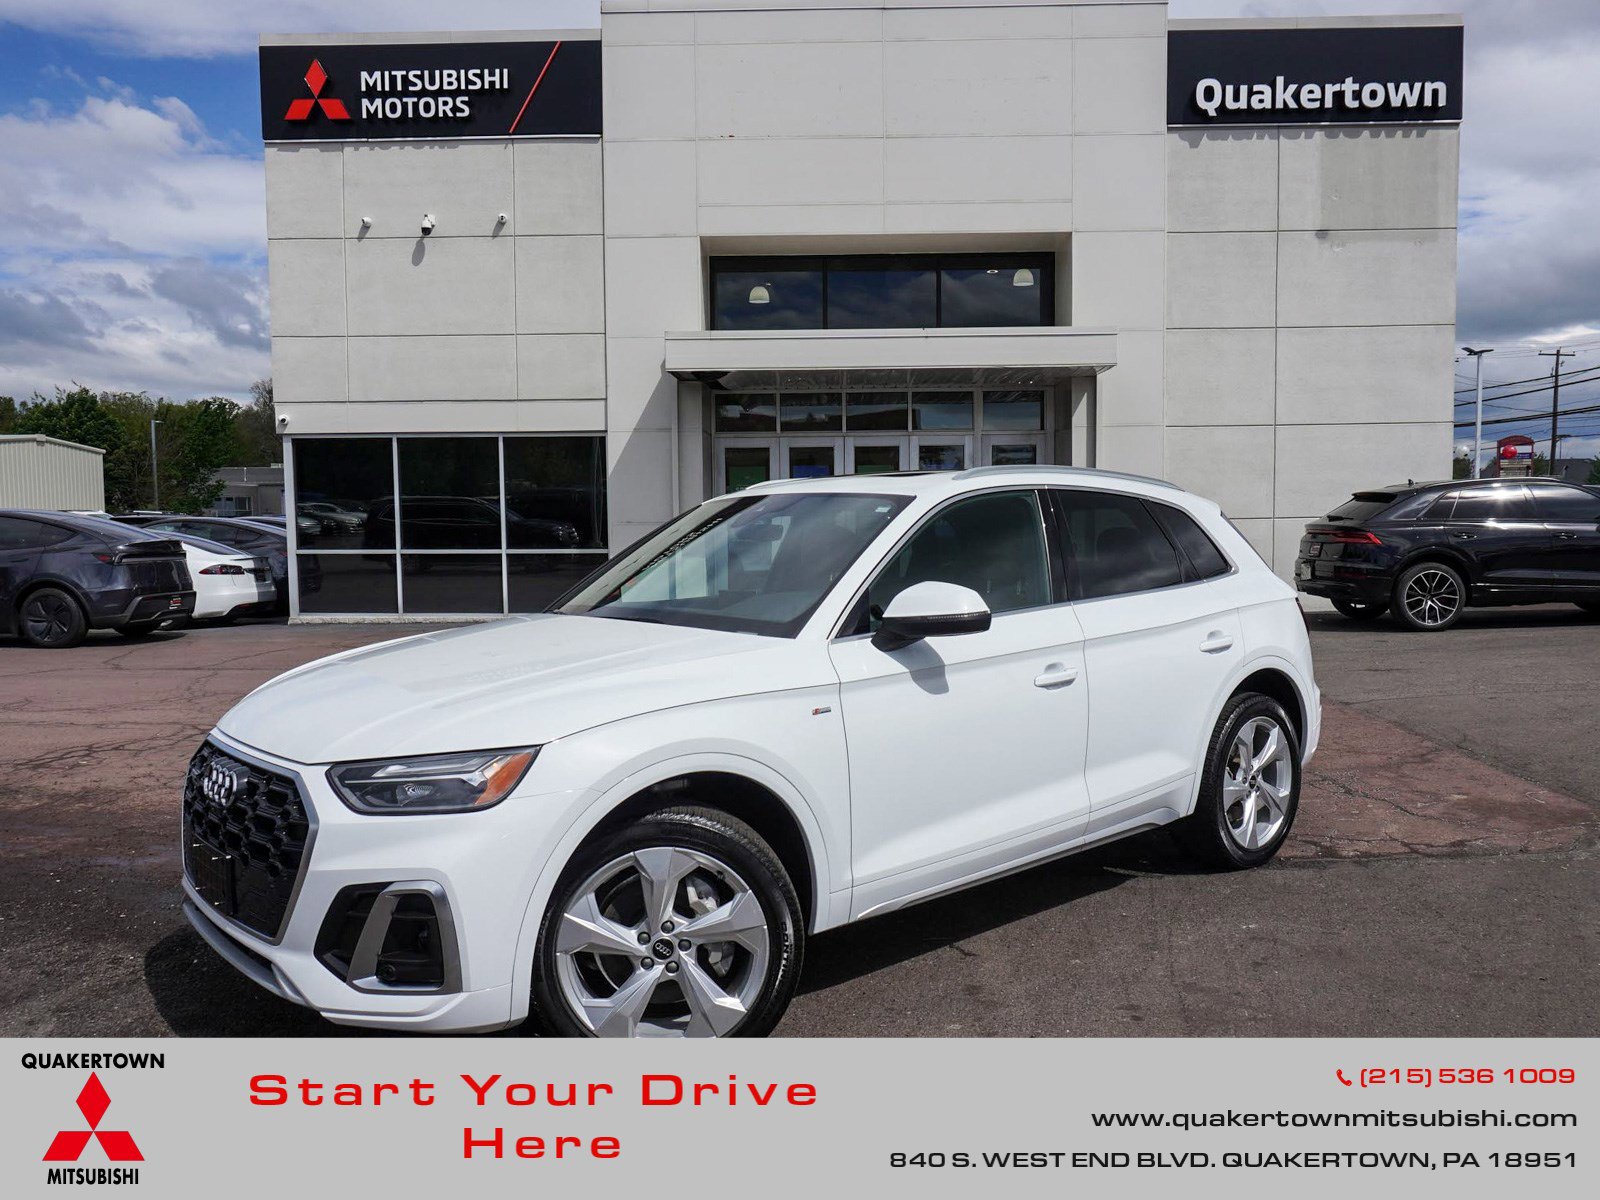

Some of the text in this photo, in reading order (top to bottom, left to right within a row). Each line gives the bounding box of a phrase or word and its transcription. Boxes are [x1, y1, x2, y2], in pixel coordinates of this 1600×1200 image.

[360, 68, 509, 92] MITSUBISHI
[361, 96, 470, 119] MOTORS
[1195, 75, 1447, 117] Quakertown
